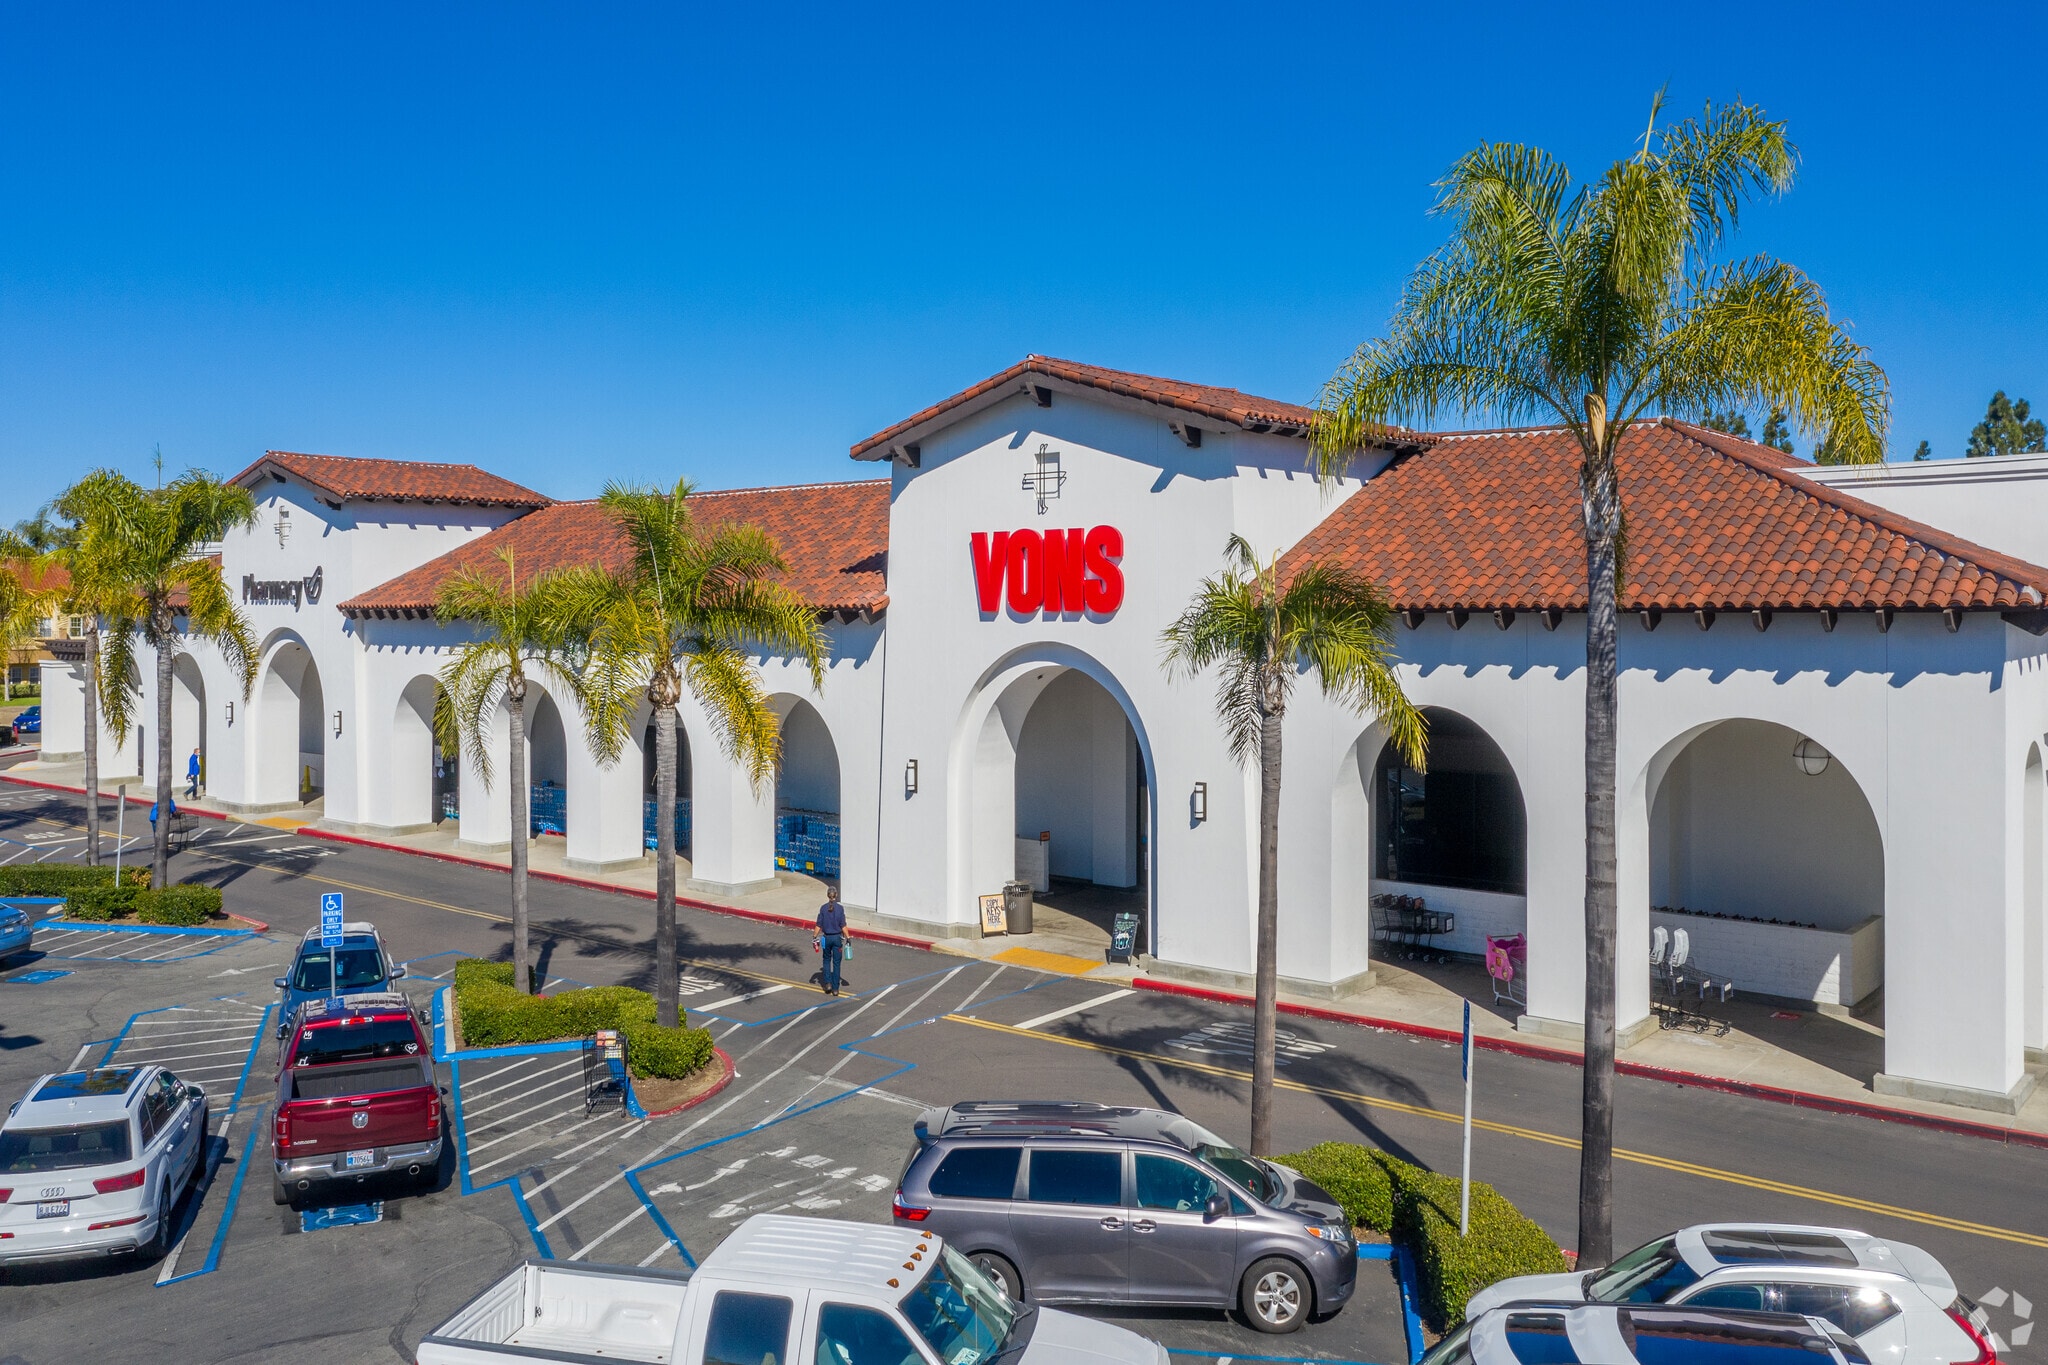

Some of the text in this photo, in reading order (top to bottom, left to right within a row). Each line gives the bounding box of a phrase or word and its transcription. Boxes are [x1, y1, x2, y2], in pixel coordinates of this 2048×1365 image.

[971, 525, 1124, 614] VONS
[243, 573, 303, 609] Pharmacy
[986, 899, 999, 907] COPY
[986, 905, 1001, 917] KEYS
[987, 915, 1001, 924] HERE
[1164, 1022, 1337, 1066] STOP
